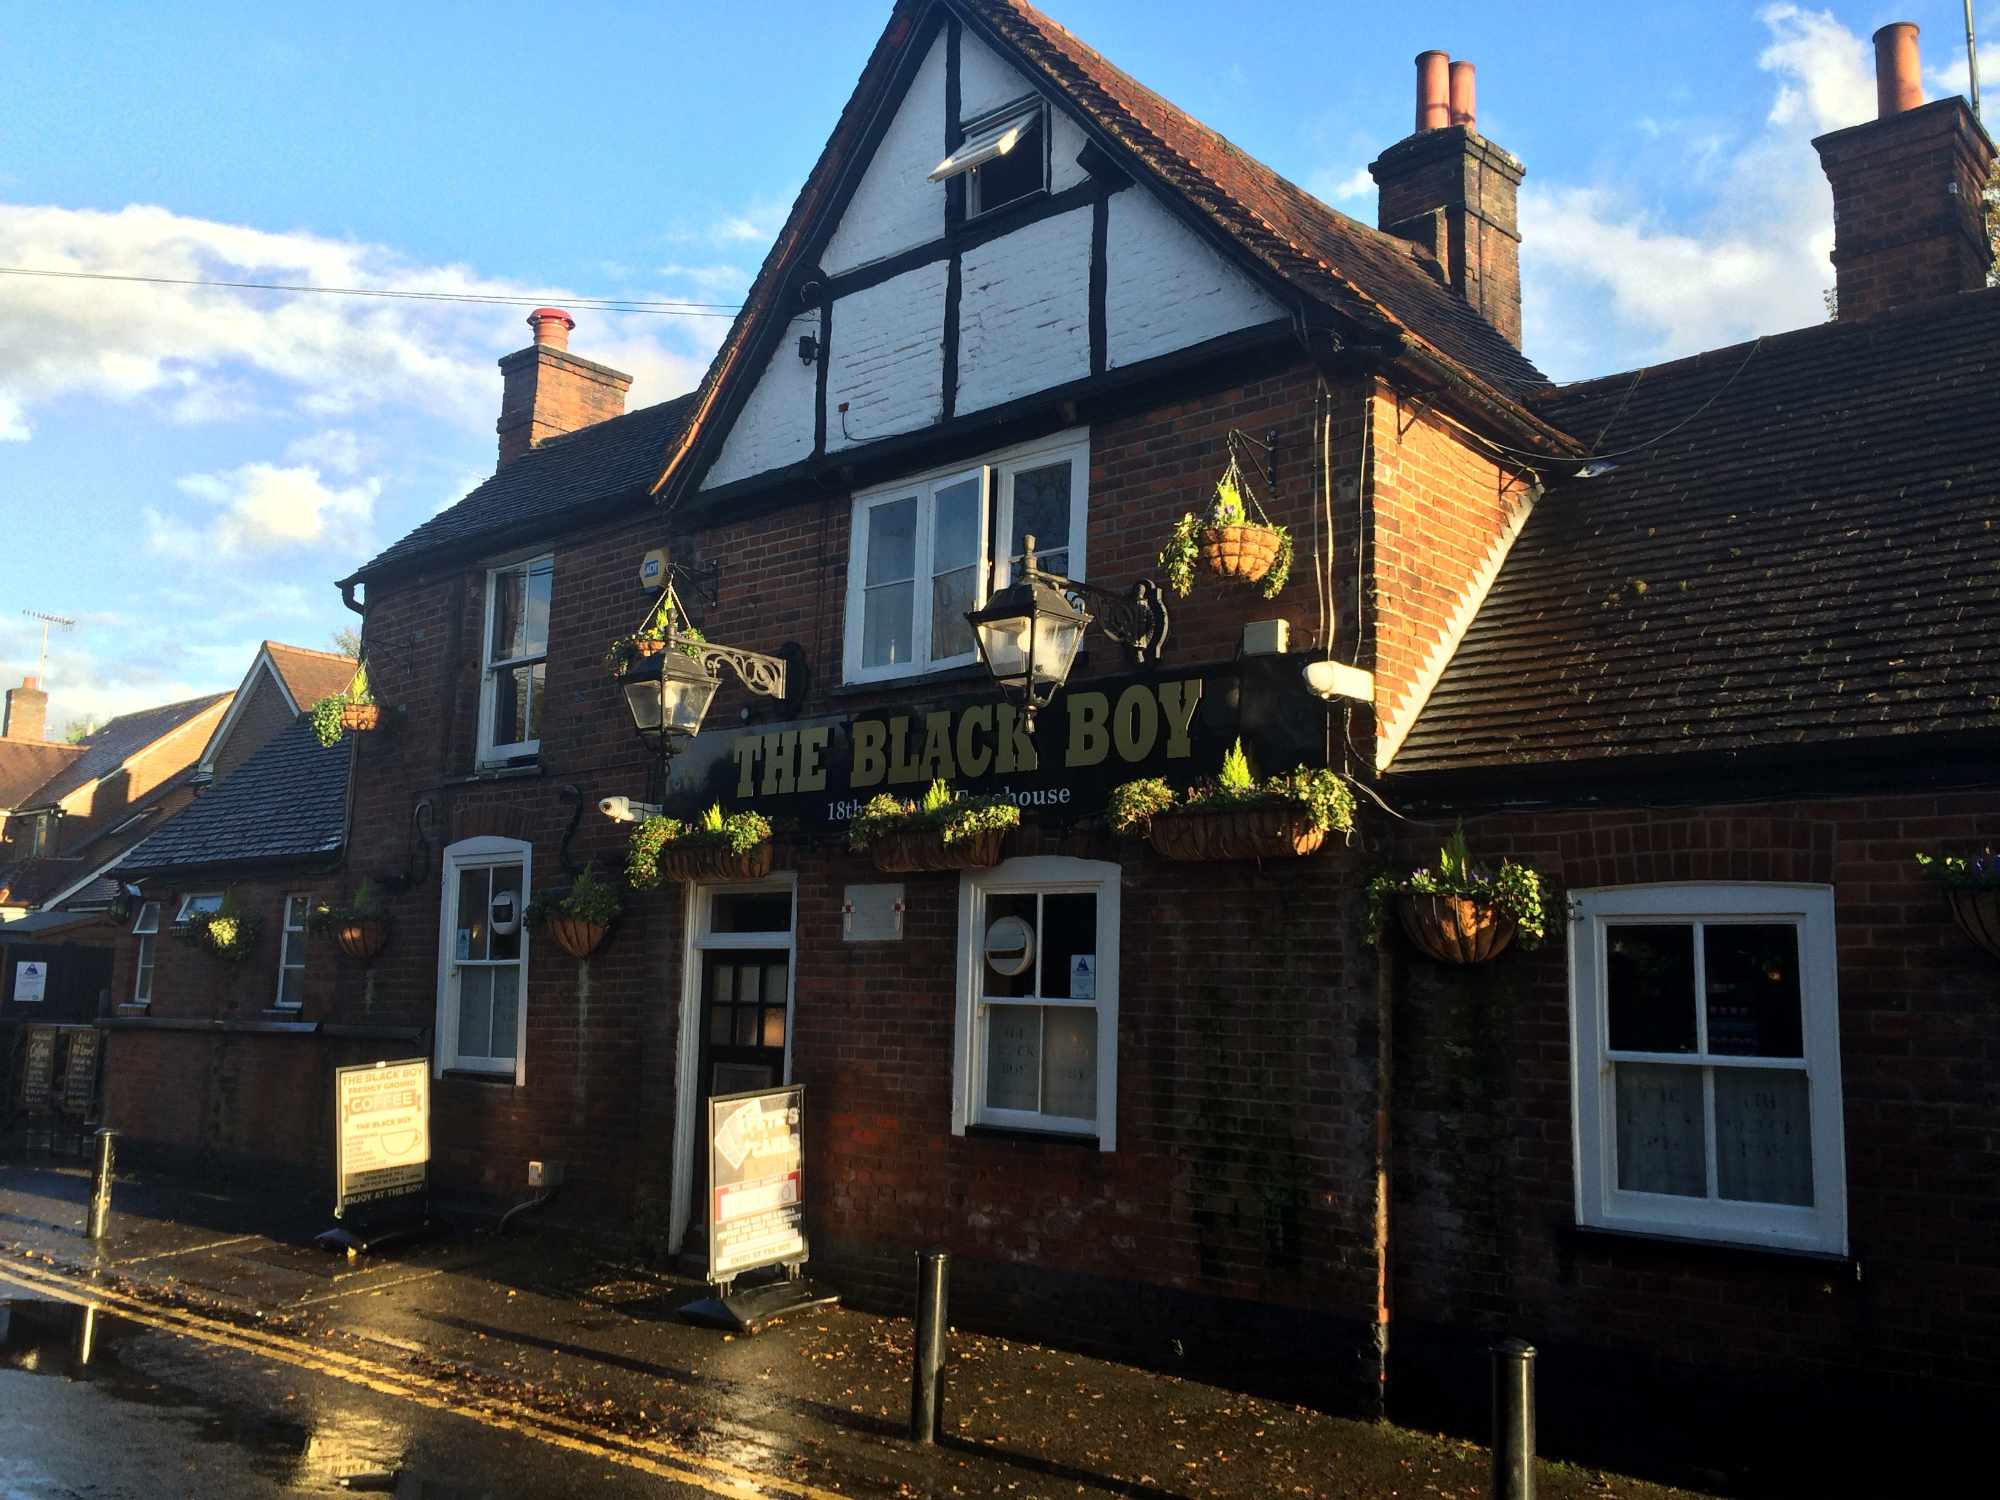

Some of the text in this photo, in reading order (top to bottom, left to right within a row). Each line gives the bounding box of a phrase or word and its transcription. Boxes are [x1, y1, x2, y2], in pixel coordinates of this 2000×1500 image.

[733, 678, 1204, 798] THE BLACK BOY
[827, 798, 865, 821] 18th
[343, 1067, 423, 1086] THE BLACK BOY
[351, 1091, 413, 1113] COFFEE
[344, 1192, 371, 1204] ENJOY
[374, 1191, 385, 1199] AT
[388, 1187, 404, 1197] THE
